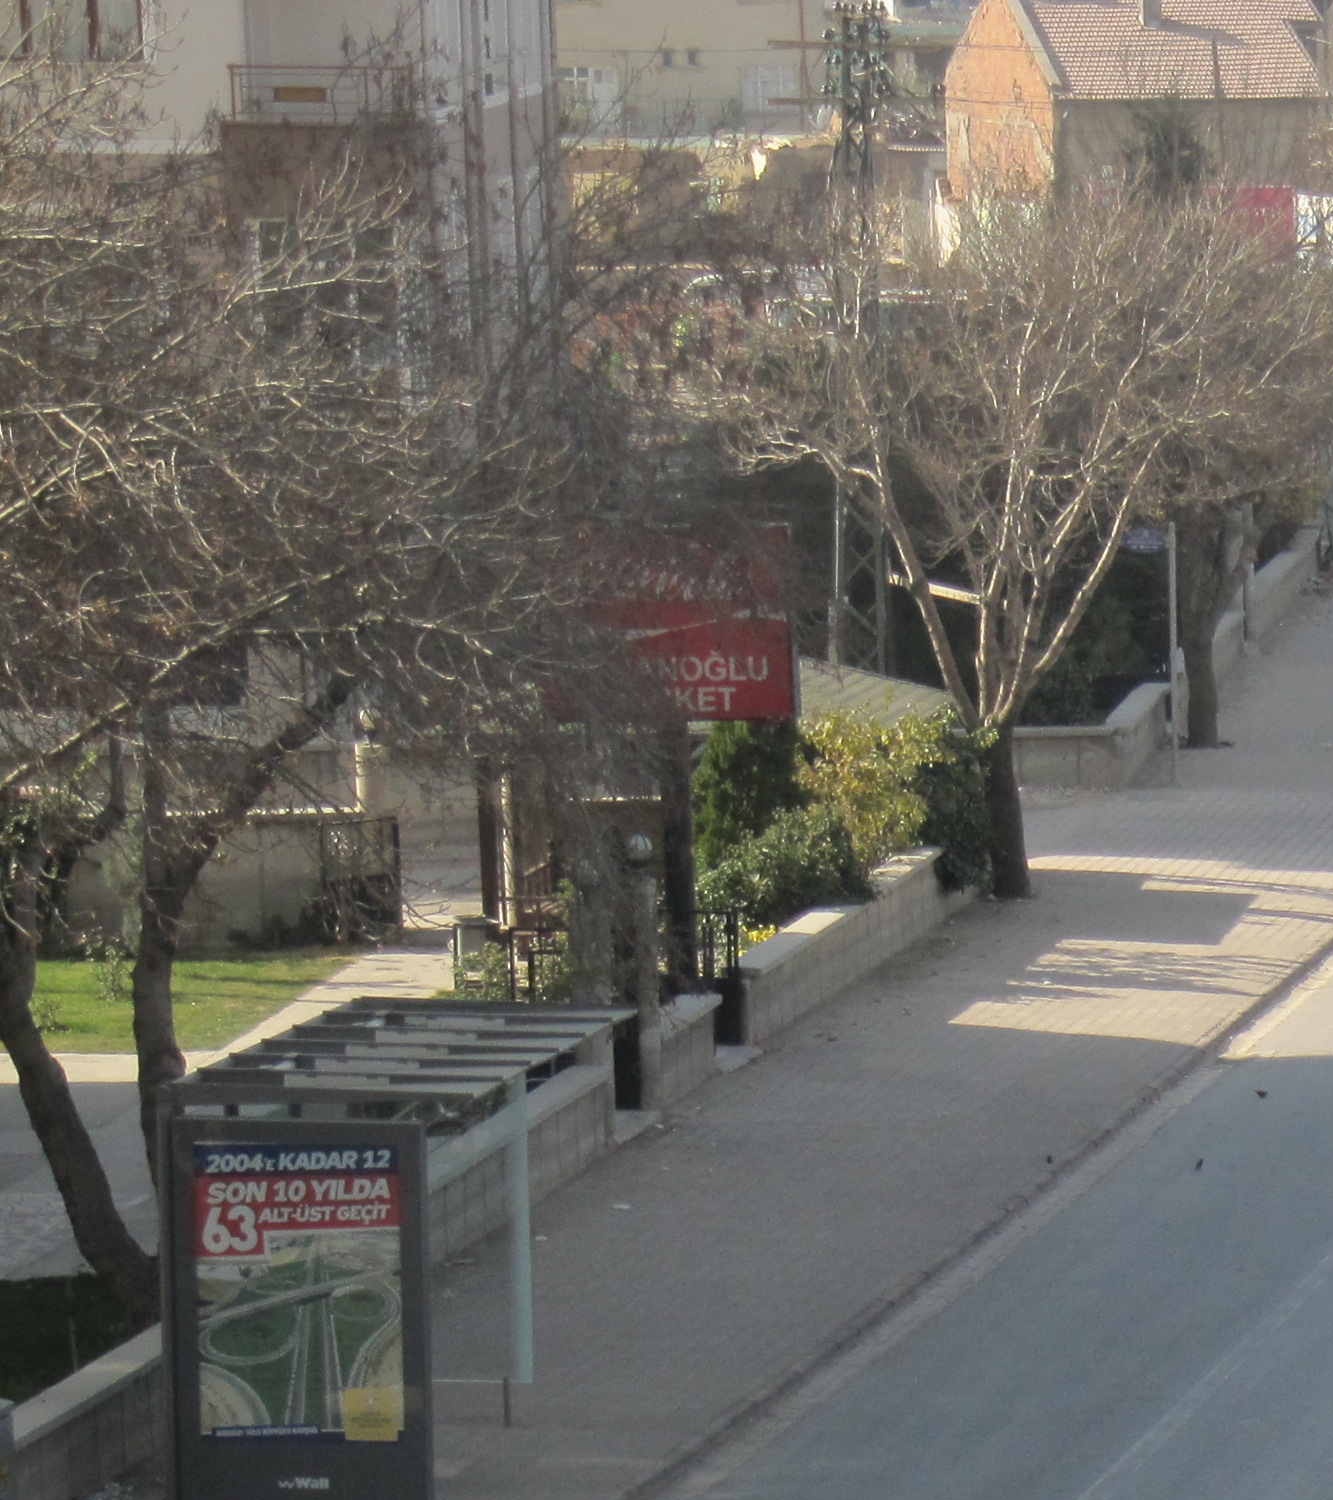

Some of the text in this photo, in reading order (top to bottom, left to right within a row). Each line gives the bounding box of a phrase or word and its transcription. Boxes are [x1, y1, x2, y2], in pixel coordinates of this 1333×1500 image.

[278, 1150, 358, 1171] KADAR
[362, 1149, 392, 1169] 12
[206, 1177, 392, 1205] SON 10 YILDA
[202, 1200, 392, 1254] 63 ALT-ÜST GEÇİT
